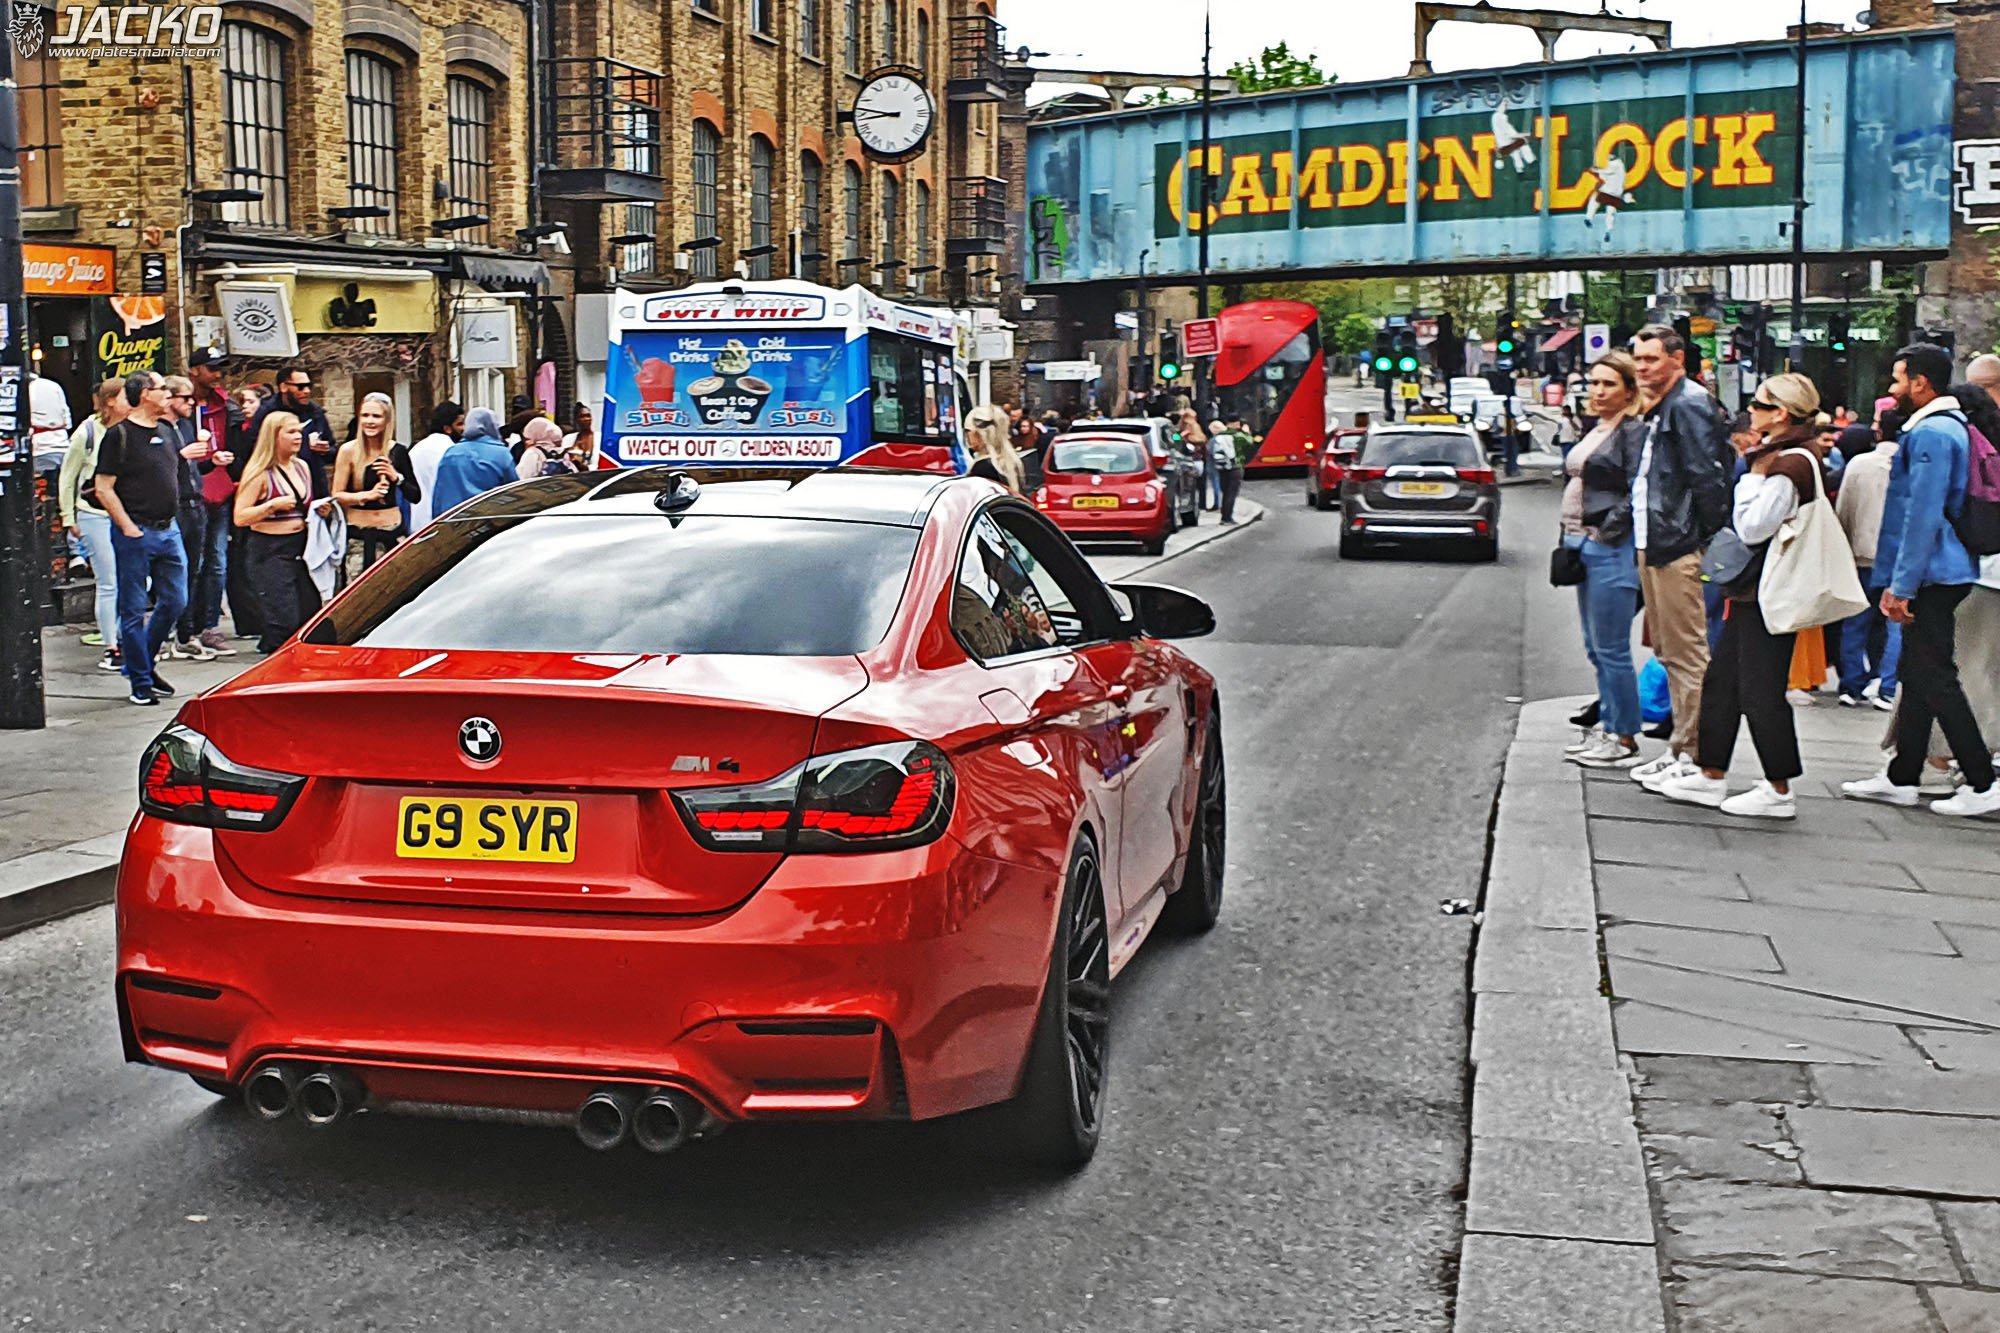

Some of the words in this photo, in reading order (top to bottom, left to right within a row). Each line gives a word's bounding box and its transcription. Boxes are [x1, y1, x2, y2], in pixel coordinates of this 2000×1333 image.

[1167, 132, 1497, 231] CAMDEN
[1534, 111, 1776, 213] LOCK
[23, 261, 67, 287] range
[67, 255, 106, 283] Juice
[658, 299, 728, 319] SOFT
[734, 298, 812, 318] WHIP
[99, 331, 163, 361] Orange
[678, 337, 702, 350] Hot
[758, 336, 786, 349] Cold
[669, 352, 710, 364] Drinks
[751, 351, 793, 363] Drinks
[626, 409, 690, 426] Slush
[706, 408, 752, 421] Coffee
[769, 409, 835, 426] Slush
[627, 439, 679, 457] WATCH
[685, 439, 717, 457] OUT
[739, 440, 793, 457] CHILDREN
[796, 440, 834, 457] ABOUT
[461, 719, 498, 735] BMW
[403, 802, 463, 849] G9
[477, 804, 571, 853] SYR
